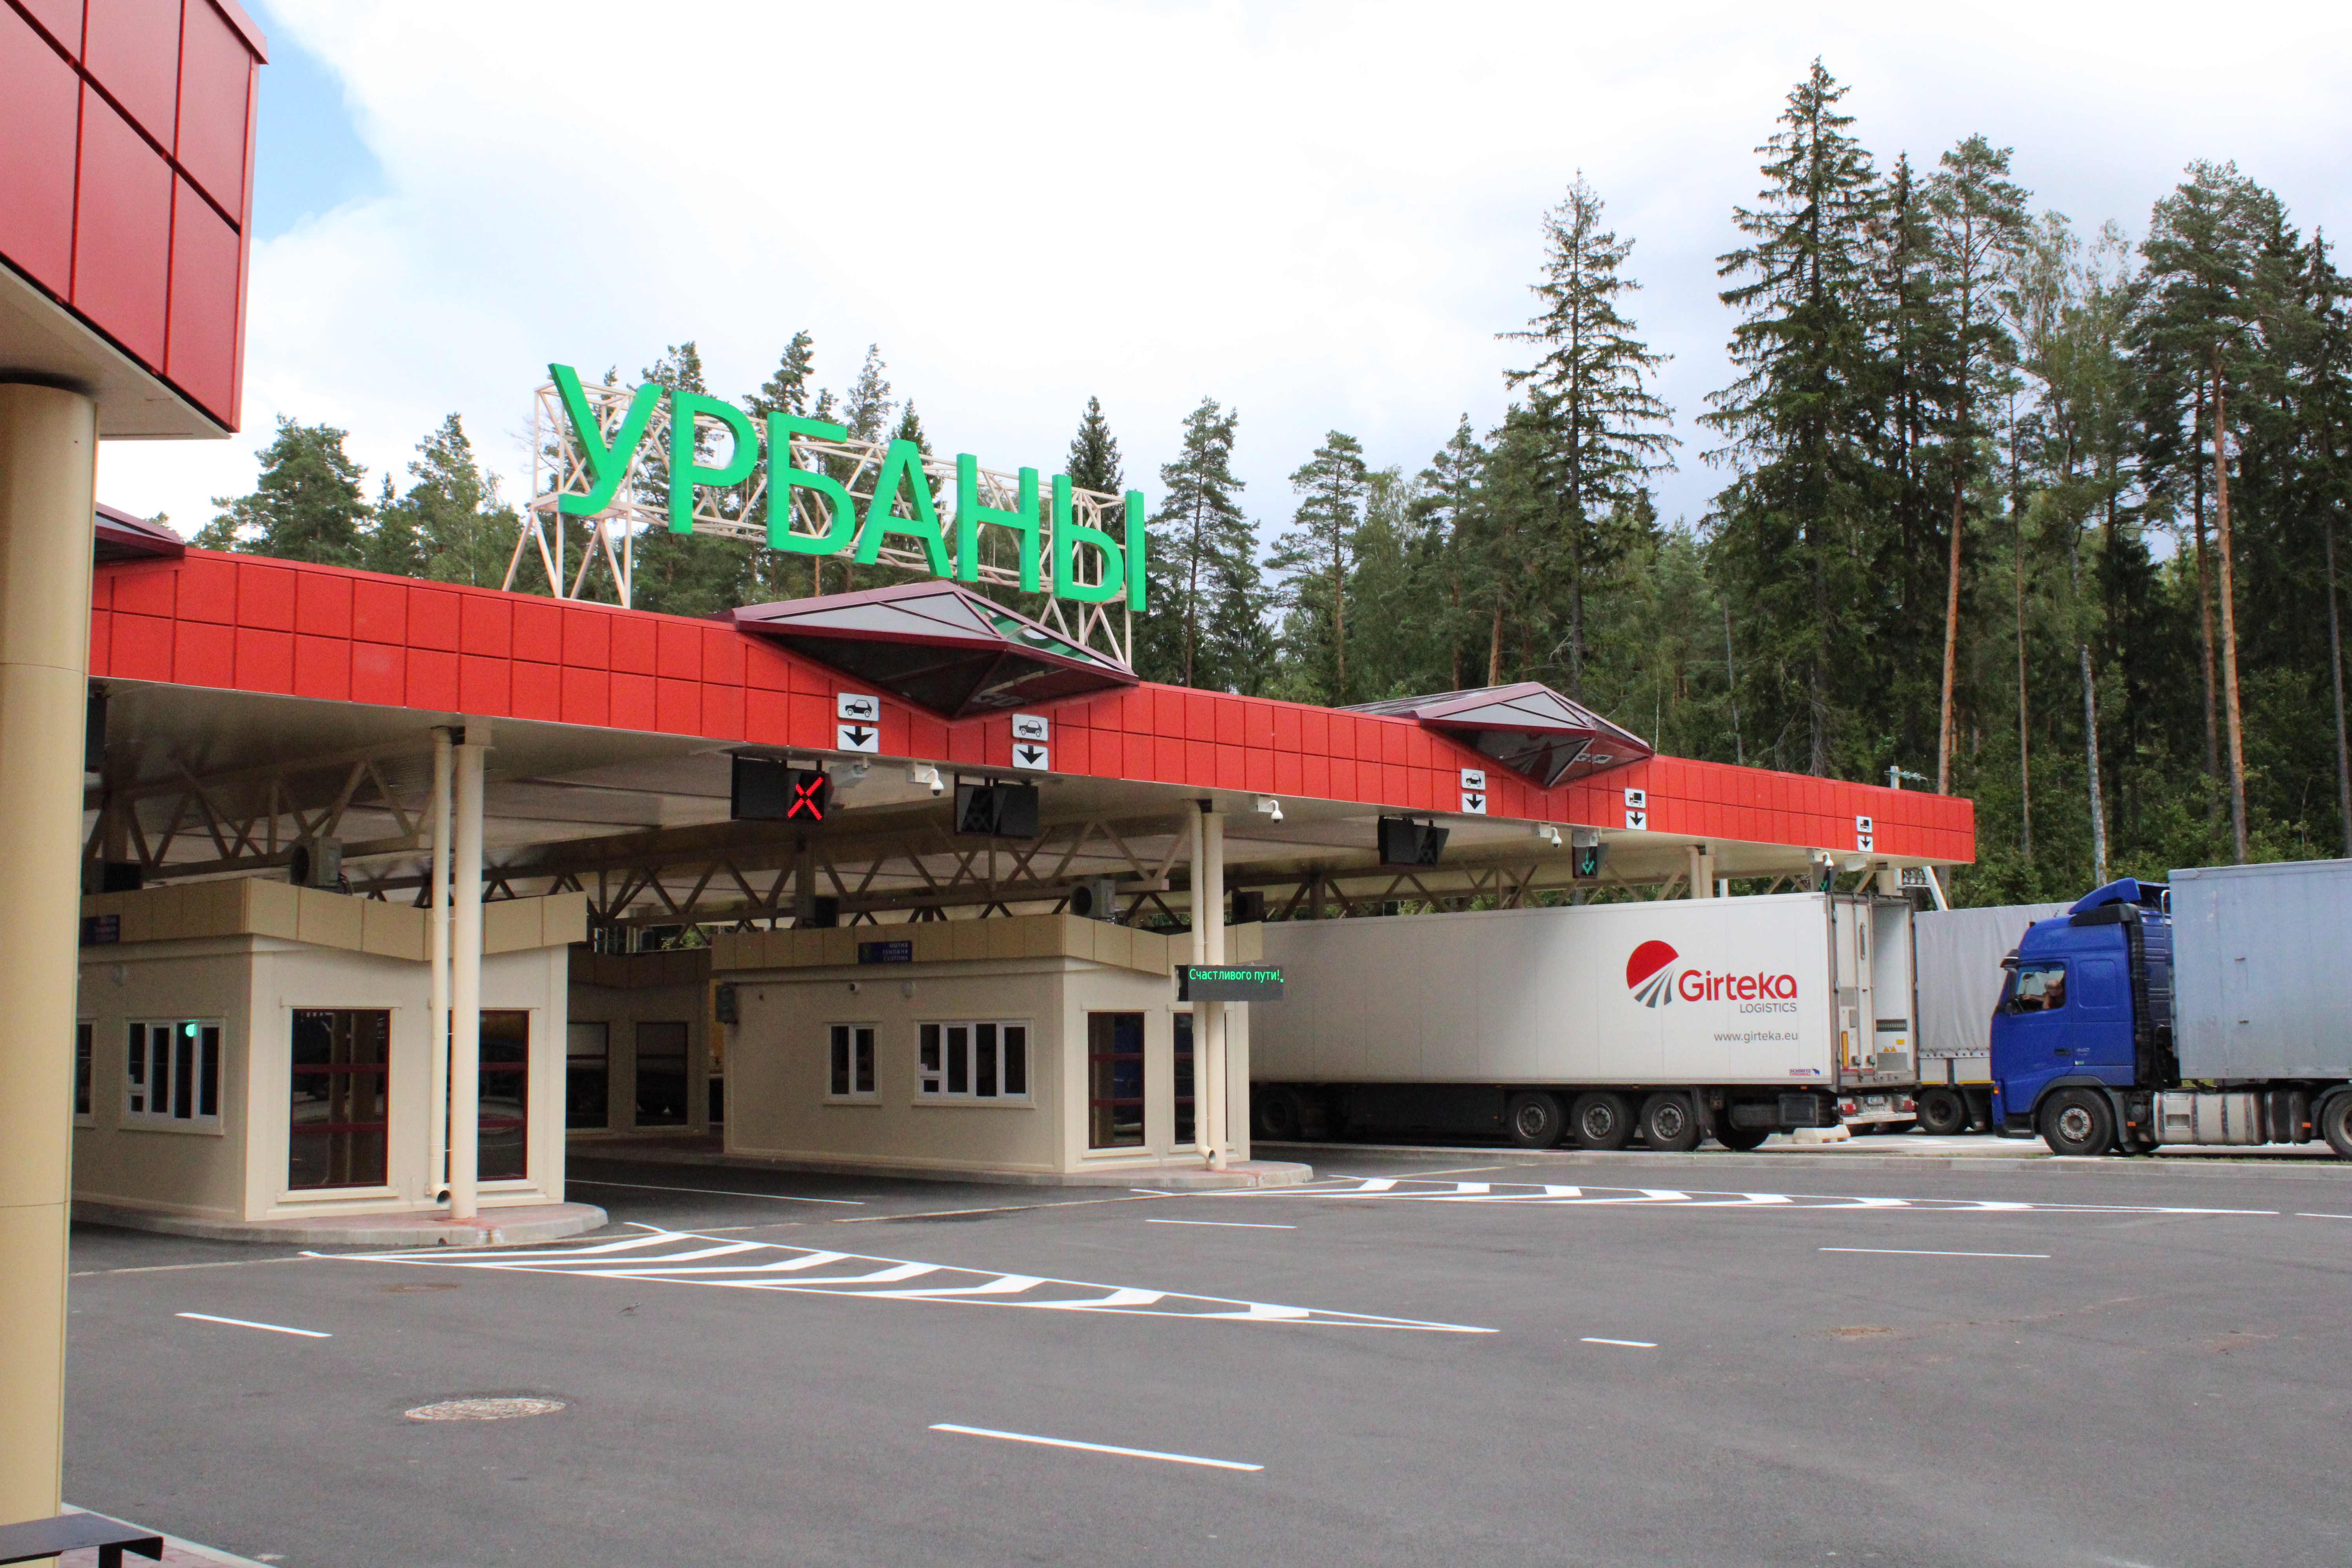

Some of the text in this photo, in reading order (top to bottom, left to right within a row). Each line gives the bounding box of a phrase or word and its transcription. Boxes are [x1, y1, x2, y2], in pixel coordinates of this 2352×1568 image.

[548, 363, 1146, 612] УРБАНЫ
[1189, 968, 1280, 983] Счастливого пути!
[1679, 969, 1797, 1002] Girteka
[1740, 1002, 1797, 1013] LOGISTICS
[1714, 1031, 1798, 1044] www.girteka.eu
